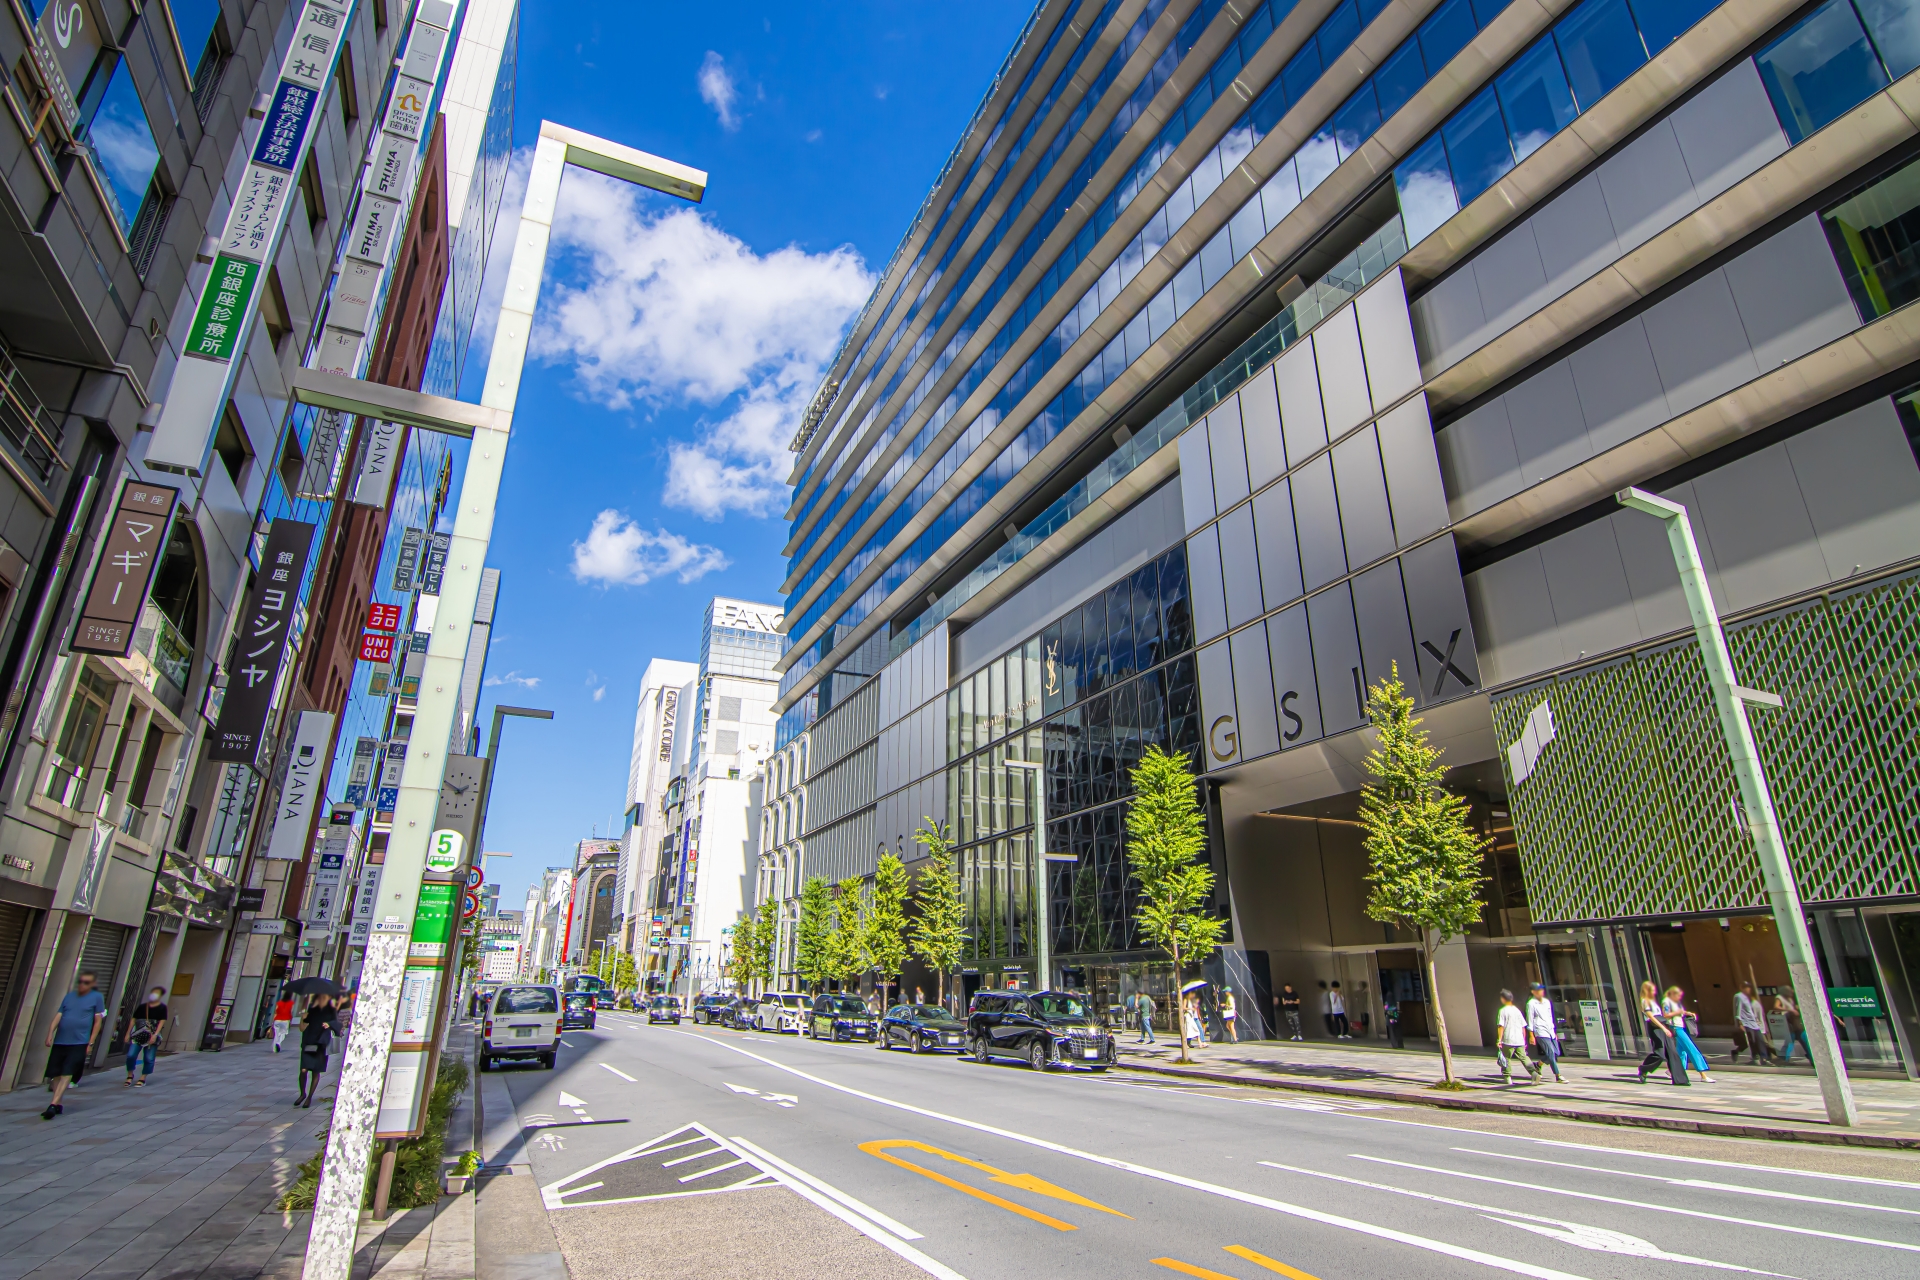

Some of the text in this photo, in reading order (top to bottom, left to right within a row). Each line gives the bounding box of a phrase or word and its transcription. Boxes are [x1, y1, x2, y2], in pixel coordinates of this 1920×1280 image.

[293, 0, 344, 80] 通信社
[262, 86, 309, 165] 銀座総合法律事務所
[392, 115, 417, 126] nobu
[393, 109, 420, 121] ginza
[379, 150, 398, 193] SHIMA
[228, 171, 265, 249] レディスクリニック
[250, 175, 283, 250] 銀座すずらん通り
[360, 212, 380, 257] SHIMA
[199, 260, 248, 354] 西銀座診療所
[335, 335, 350, 346] 4F
[329, 369, 349, 377] coco
[369, 421, 396, 474] DIANA
[133, 491, 164, 506] 銀座
[112, 520, 154, 605] マギー
[426, 553, 443, 592] 岩崎ビル
[87, 633, 121, 644] 1956
[88, 625, 122, 637] SINCE
[366, 636, 389, 648] UNI
[364, 647, 388, 659] QLO
[1209, 628, 1475, 762] G SIX
[223, 733, 252, 744] SINCE
[660, 690, 677, 763] GINZA CORE
[222, 742, 250, 752] 1907
[285, 755, 316, 820] DIANA
[437, 834, 453, 854] 5
[360, 870, 377, 914] 岩崎眼鏡店
[471, 872, 479, 884] 0
[315, 898, 330, 919] 菊水
